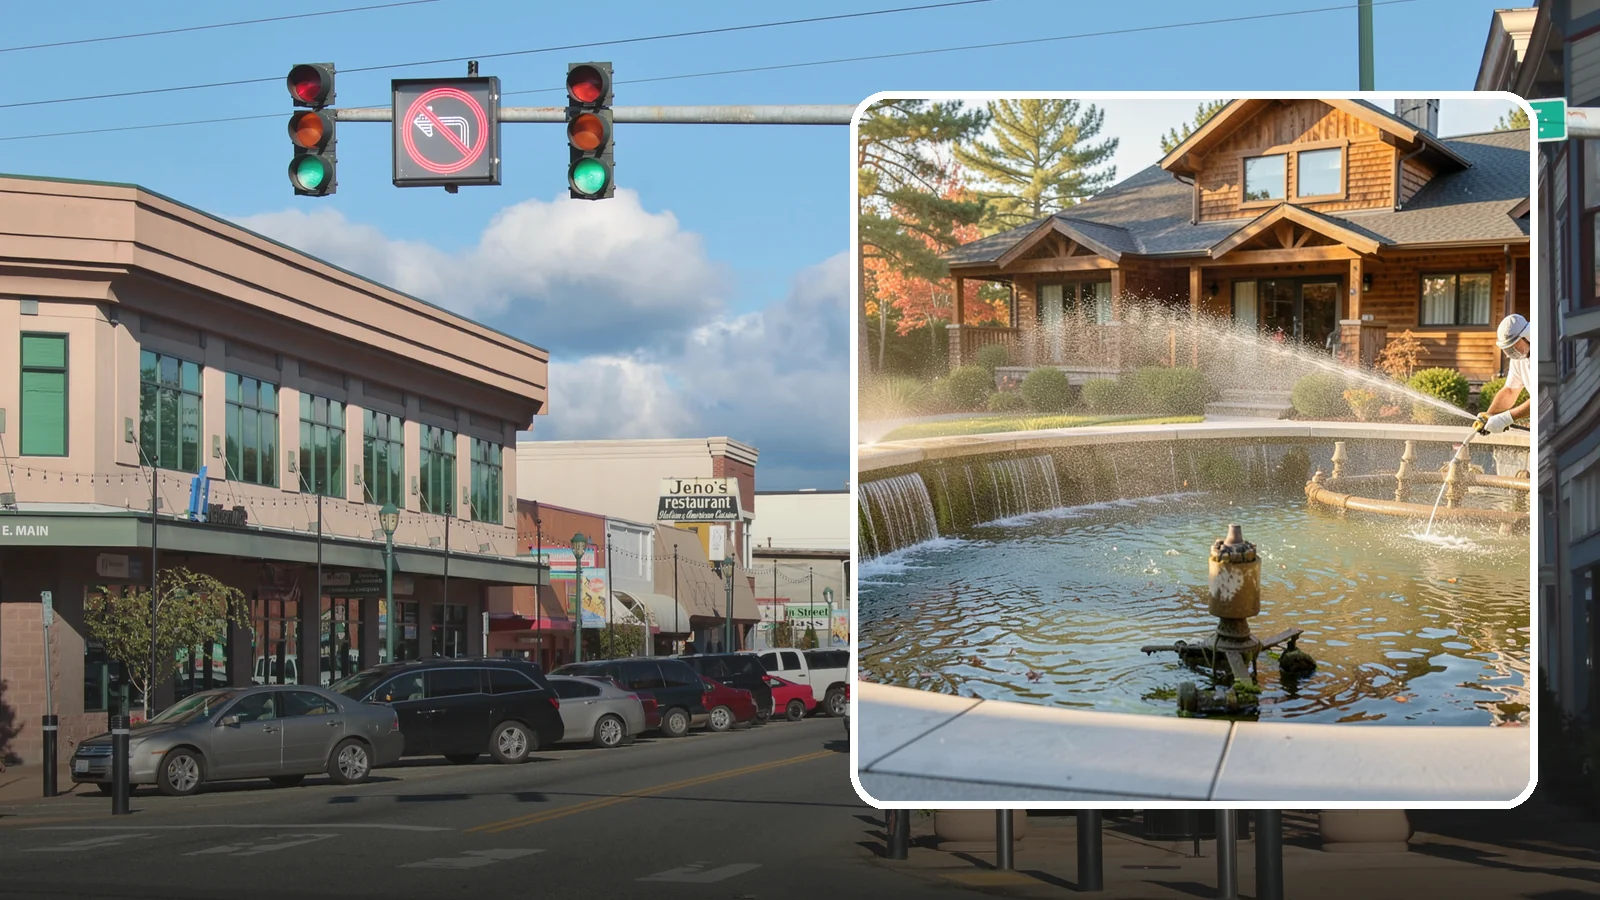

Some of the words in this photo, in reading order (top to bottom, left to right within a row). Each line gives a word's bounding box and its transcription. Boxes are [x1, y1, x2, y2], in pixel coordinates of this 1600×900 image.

[670, 480, 727, 494] Jeno's
[665, 497, 731, 509] restaurant
[658, 510, 681, 519] Italian
[686, 509, 714, 519] American
[715, 509, 737, 519] Cuisine
[2, 525, 13, 536] E.
[15, 525, 49, 536] MAIN
[797, 608, 828, 617] Street
[790, 619, 823, 627] lass
